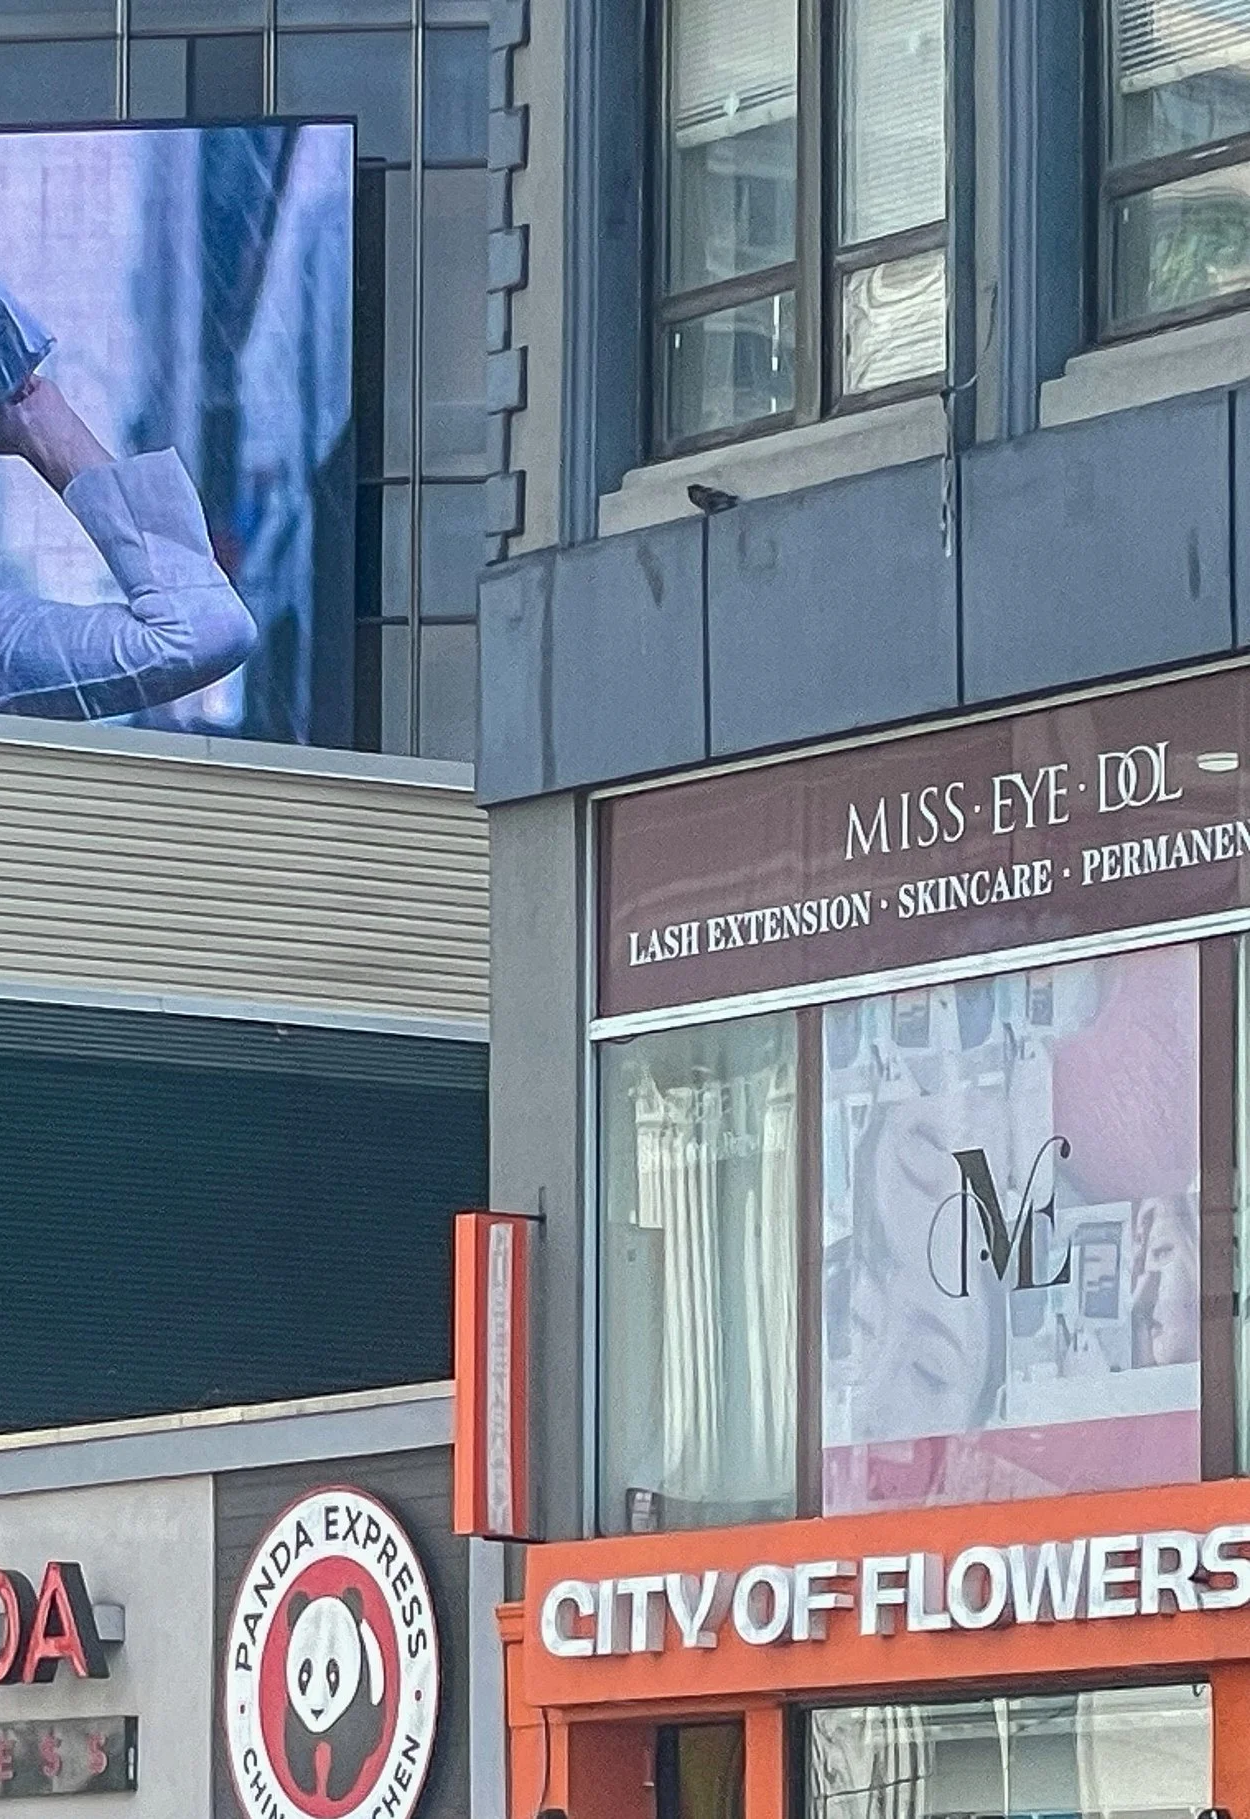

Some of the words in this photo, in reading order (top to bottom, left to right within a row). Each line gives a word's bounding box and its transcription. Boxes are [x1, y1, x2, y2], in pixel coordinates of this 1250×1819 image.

[845, 782, 965, 861] MISS
[991, 763, 1070, 835] EYE
[629, 921, 701, 967] LASH
[707, 890, 872, 953] EXTENSION
[899, 859, 1054, 920] SKINCARE
[1081, 818, 1250, 886] PERMANEN
[234, 1520, 314, 1672] PANDA
[323, 1505, 428, 1659] EXPRESS
[541, 1569, 739, 1657] CITY
[732, 1559, 856, 1646] OF
[859, 1523, 1250, 1637] FLOWERS
